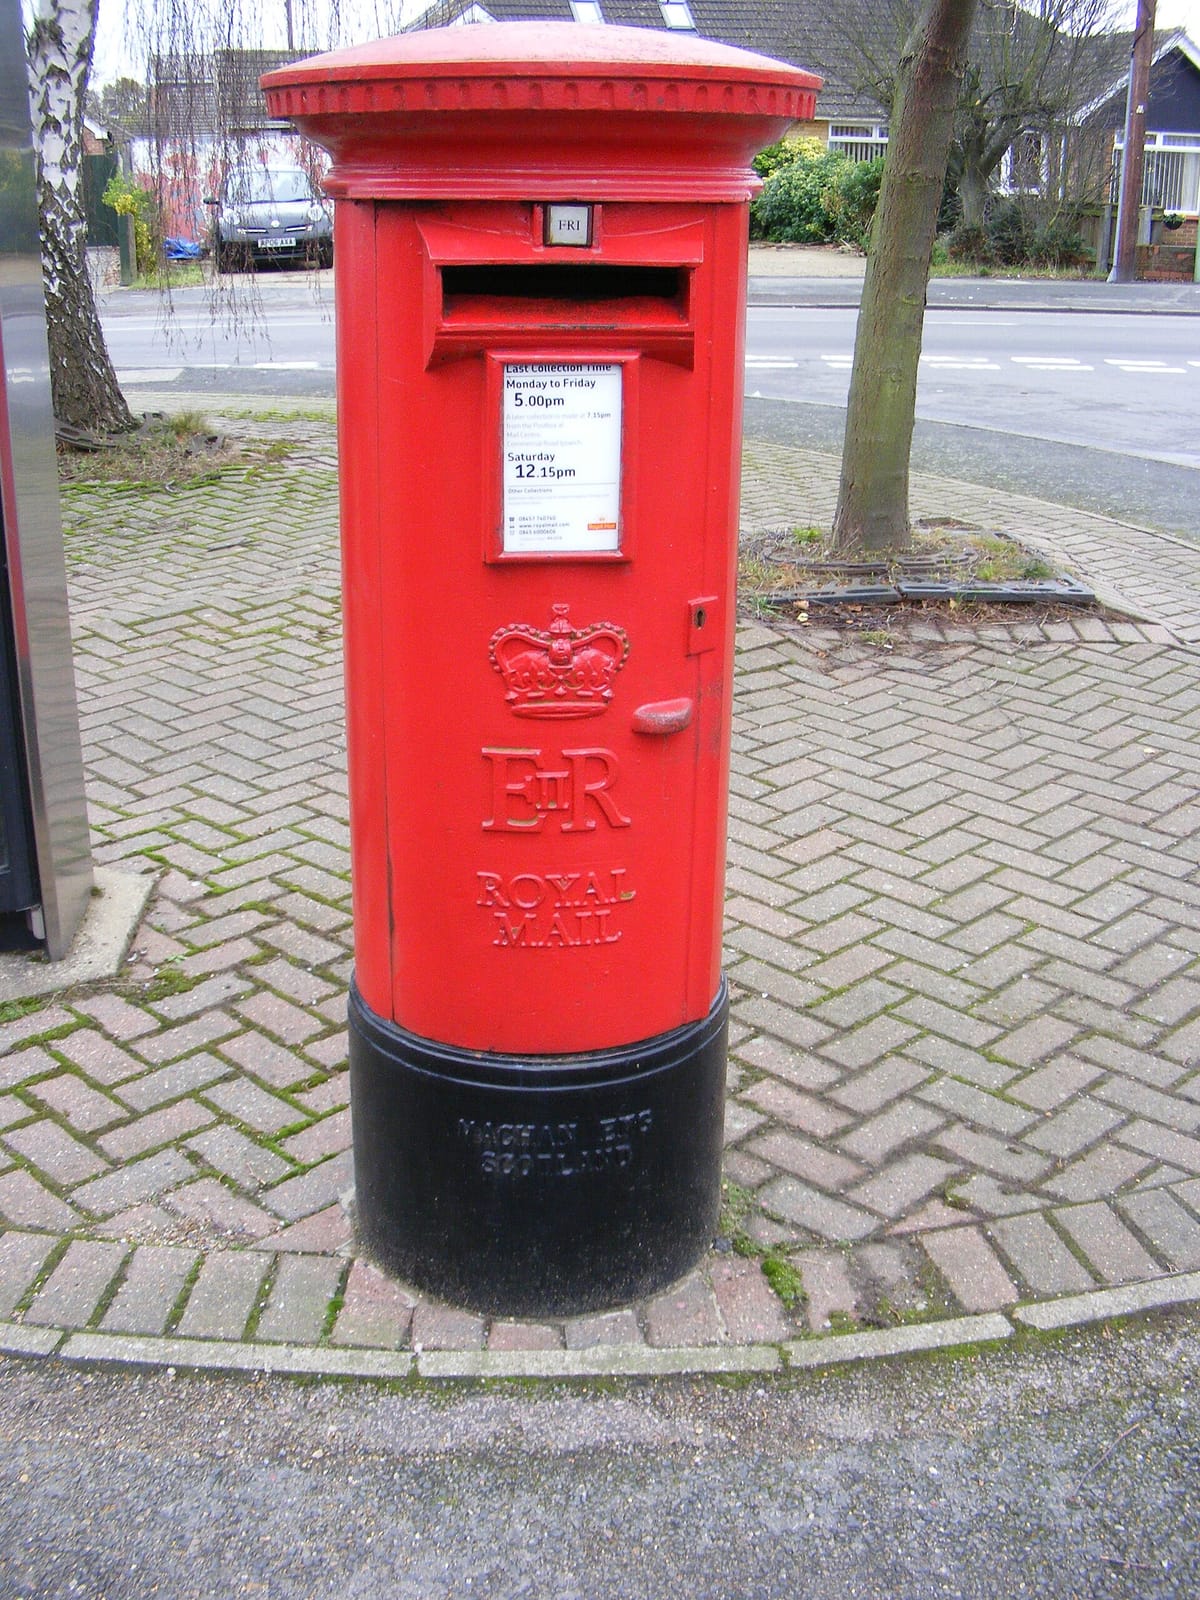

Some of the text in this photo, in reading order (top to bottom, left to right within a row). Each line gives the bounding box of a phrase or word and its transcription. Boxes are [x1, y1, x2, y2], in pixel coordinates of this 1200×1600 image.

[559, 219, 580, 231] FRI
[506, 363, 612, 374] Last Collection Time
[506, 378, 596, 391] Monday to Friday
[514, 392, 565, 408] 5.00pm
[507, 452, 555, 462] Saturday
[515, 464, 576, 479] 12.15pm
[476, 868, 637, 908] ROYAL
[492, 909, 623, 947] MAIL
[481, 1144, 633, 1176] SCOTLAND
